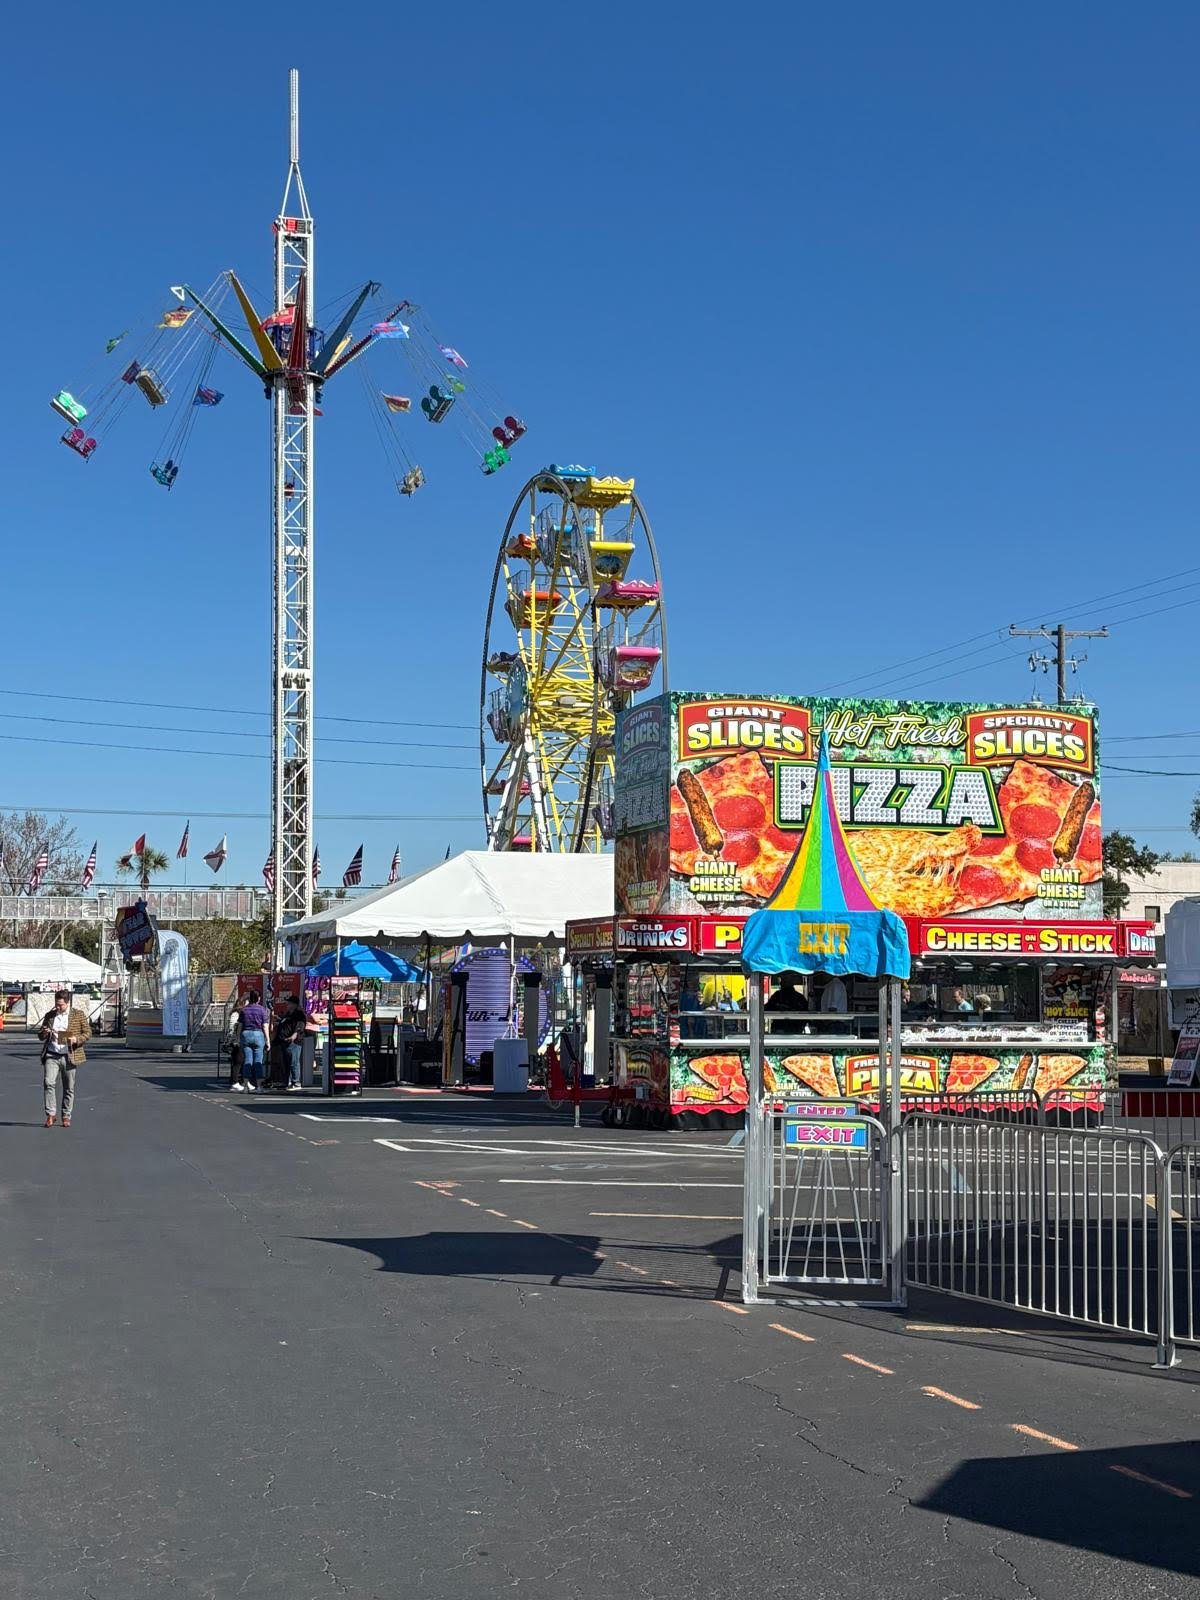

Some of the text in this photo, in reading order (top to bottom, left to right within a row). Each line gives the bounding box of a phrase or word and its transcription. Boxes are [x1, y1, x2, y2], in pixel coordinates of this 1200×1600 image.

[707, 706, 786, 720] GIANT
[809, 710, 967, 749] Hot Fresh
[983, 715, 1076, 732] SPECIALTY
[623, 721, 660, 753] SLICES
[687, 718, 806, 754] SLICES
[974, 729, 1087, 763] SLICES
[779, 764, 997, 826] PIZZA
[694, 861, 738, 876] GIANT
[1040, 868, 1081, 883] GIANT
[690, 877, 742, 892] CHEESE
[1037, 884, 1086, 899] CHEESE
[713, 893, 735, 902] STICK
[618, 926, 688, 947] DRINKS
[798, 922, 851, 955] EXIT
[926, 927, 1023, 952] CHEESE
[1025, 934, 1037, 942] ON
[1039, 928, 1114, 952] STICK
[1046, 1006, 1089, 1017] HOT SLICE
[797, 1125, 855, 1144] EXIT
